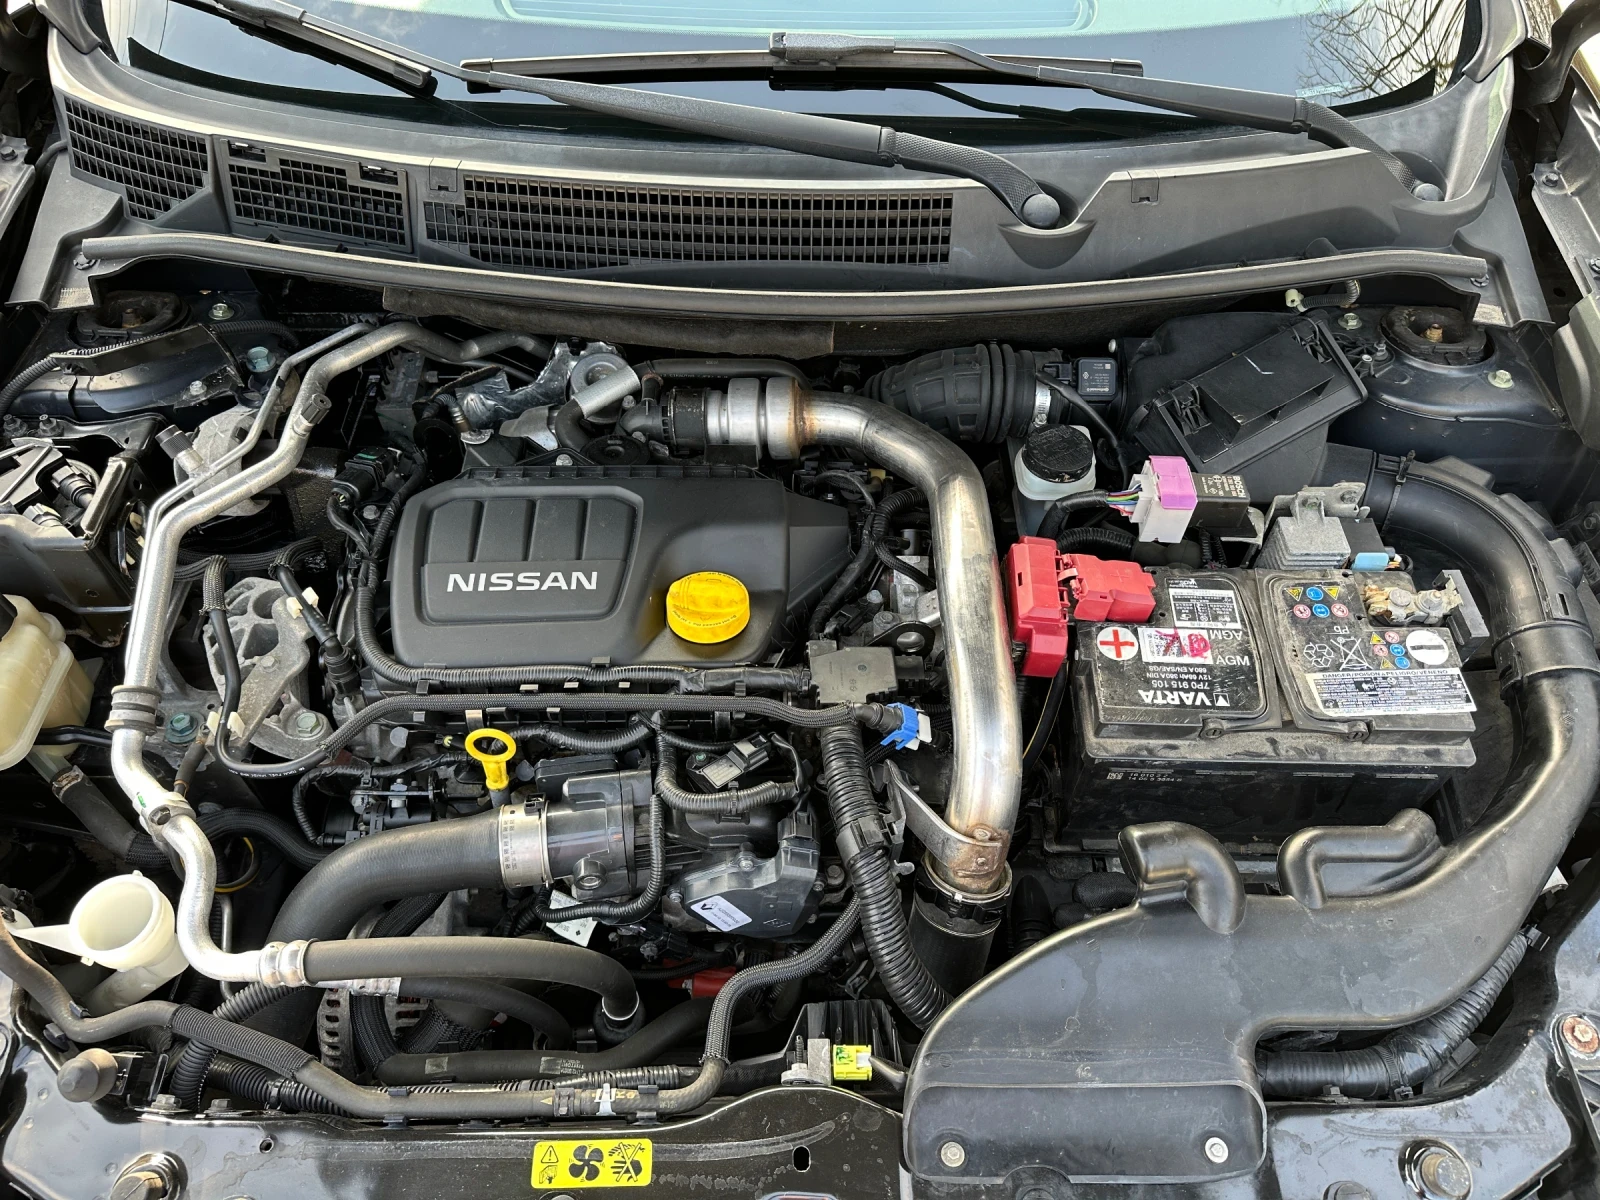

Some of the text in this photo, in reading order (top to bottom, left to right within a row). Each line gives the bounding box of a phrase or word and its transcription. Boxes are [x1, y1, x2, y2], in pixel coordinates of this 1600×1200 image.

[1233, 475, 1246, 498] BOSCH
[447, 571, 598, 593] NISSAN
[1210, 629, 1243, 640] AGM
[1334, 625, 1349, 634] Pb
[1216, 655, 1250, 666] AGM
[1151, 680, 1210, 690] 7P0 915 105
[1138, 689, 1212, 706] VARTA
